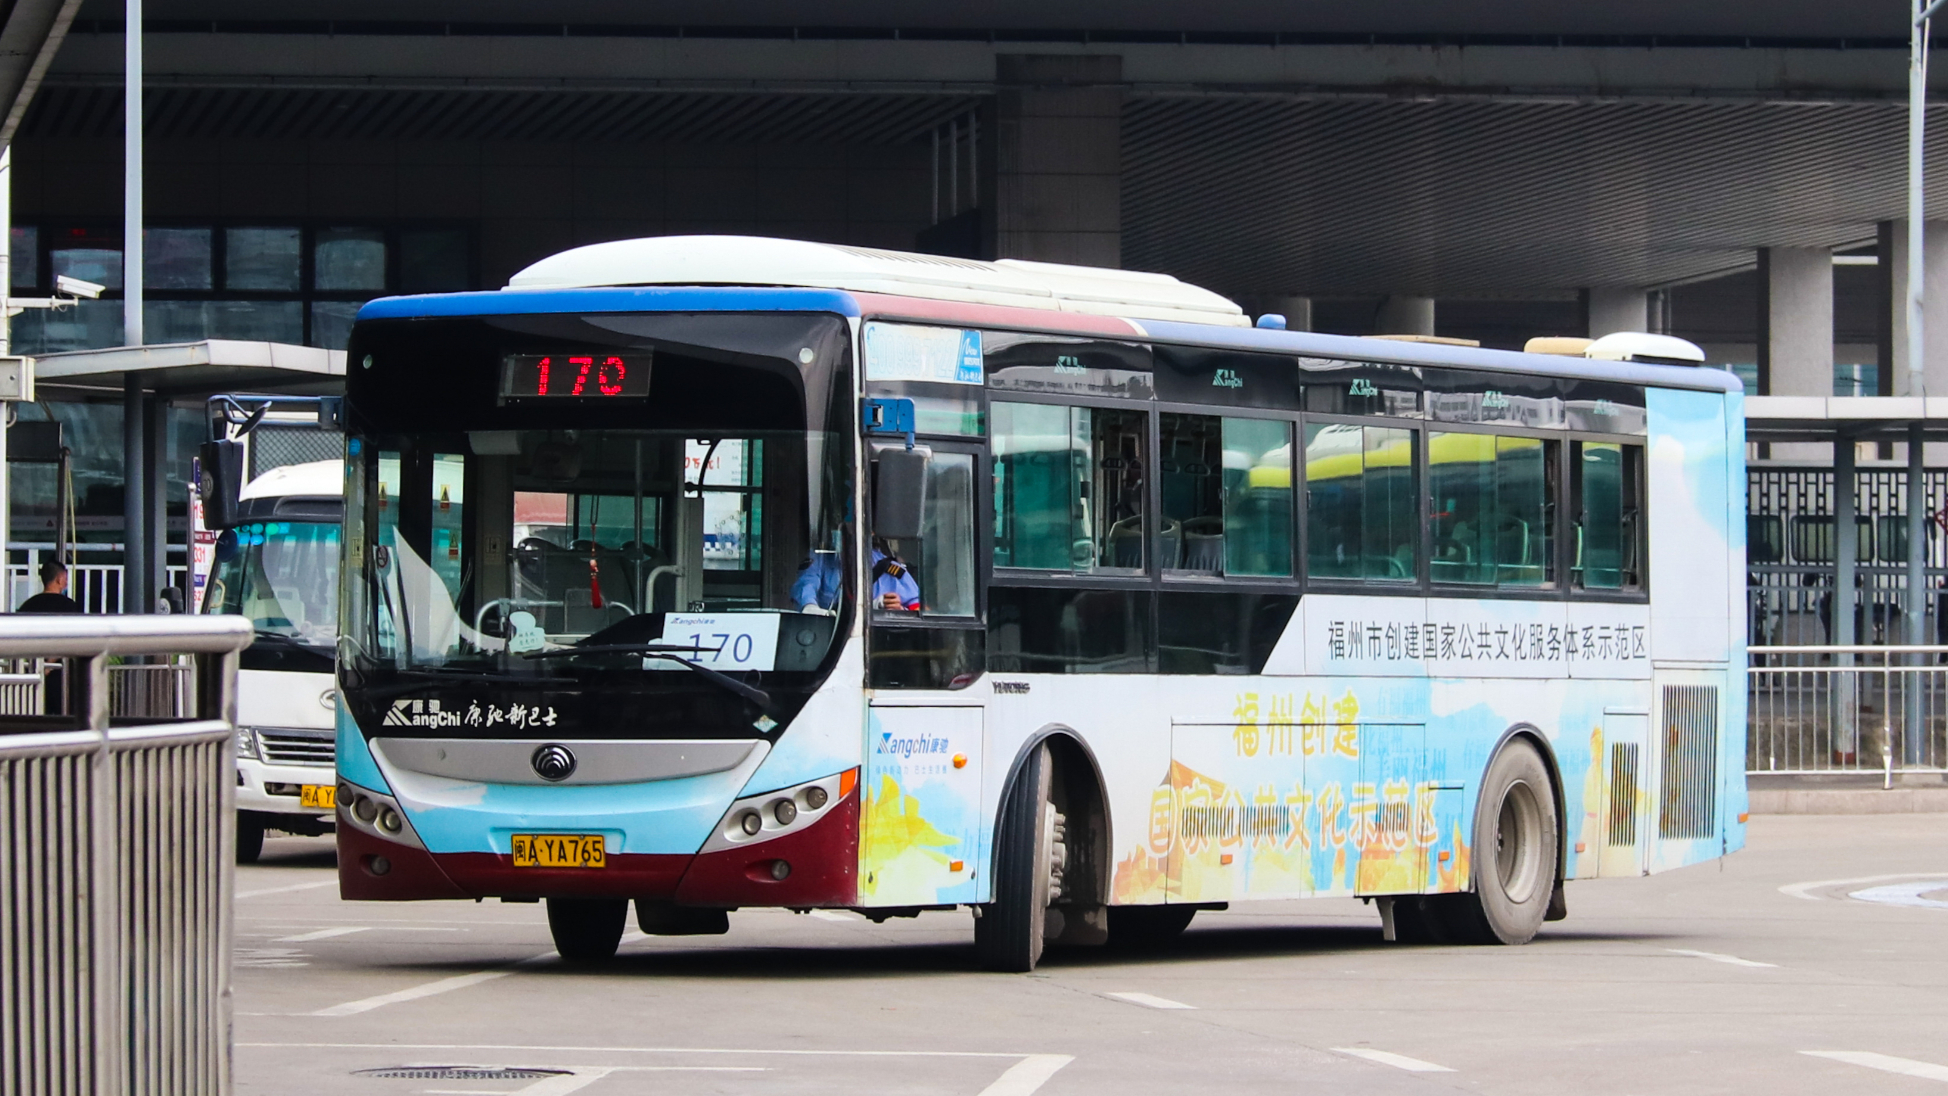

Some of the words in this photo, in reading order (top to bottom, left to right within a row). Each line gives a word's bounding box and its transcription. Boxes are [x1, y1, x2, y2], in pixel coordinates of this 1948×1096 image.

[537, 357, 626, 396] 170
[686, 633, 753, 663] 170
[1328, 619, 1647, 662] 福州市创建国家公共文化服务体系示范区
[1232, 690, 1360, 757] 福州创建
[1148, 778, 1437, 856] 国家公共文化示范区
